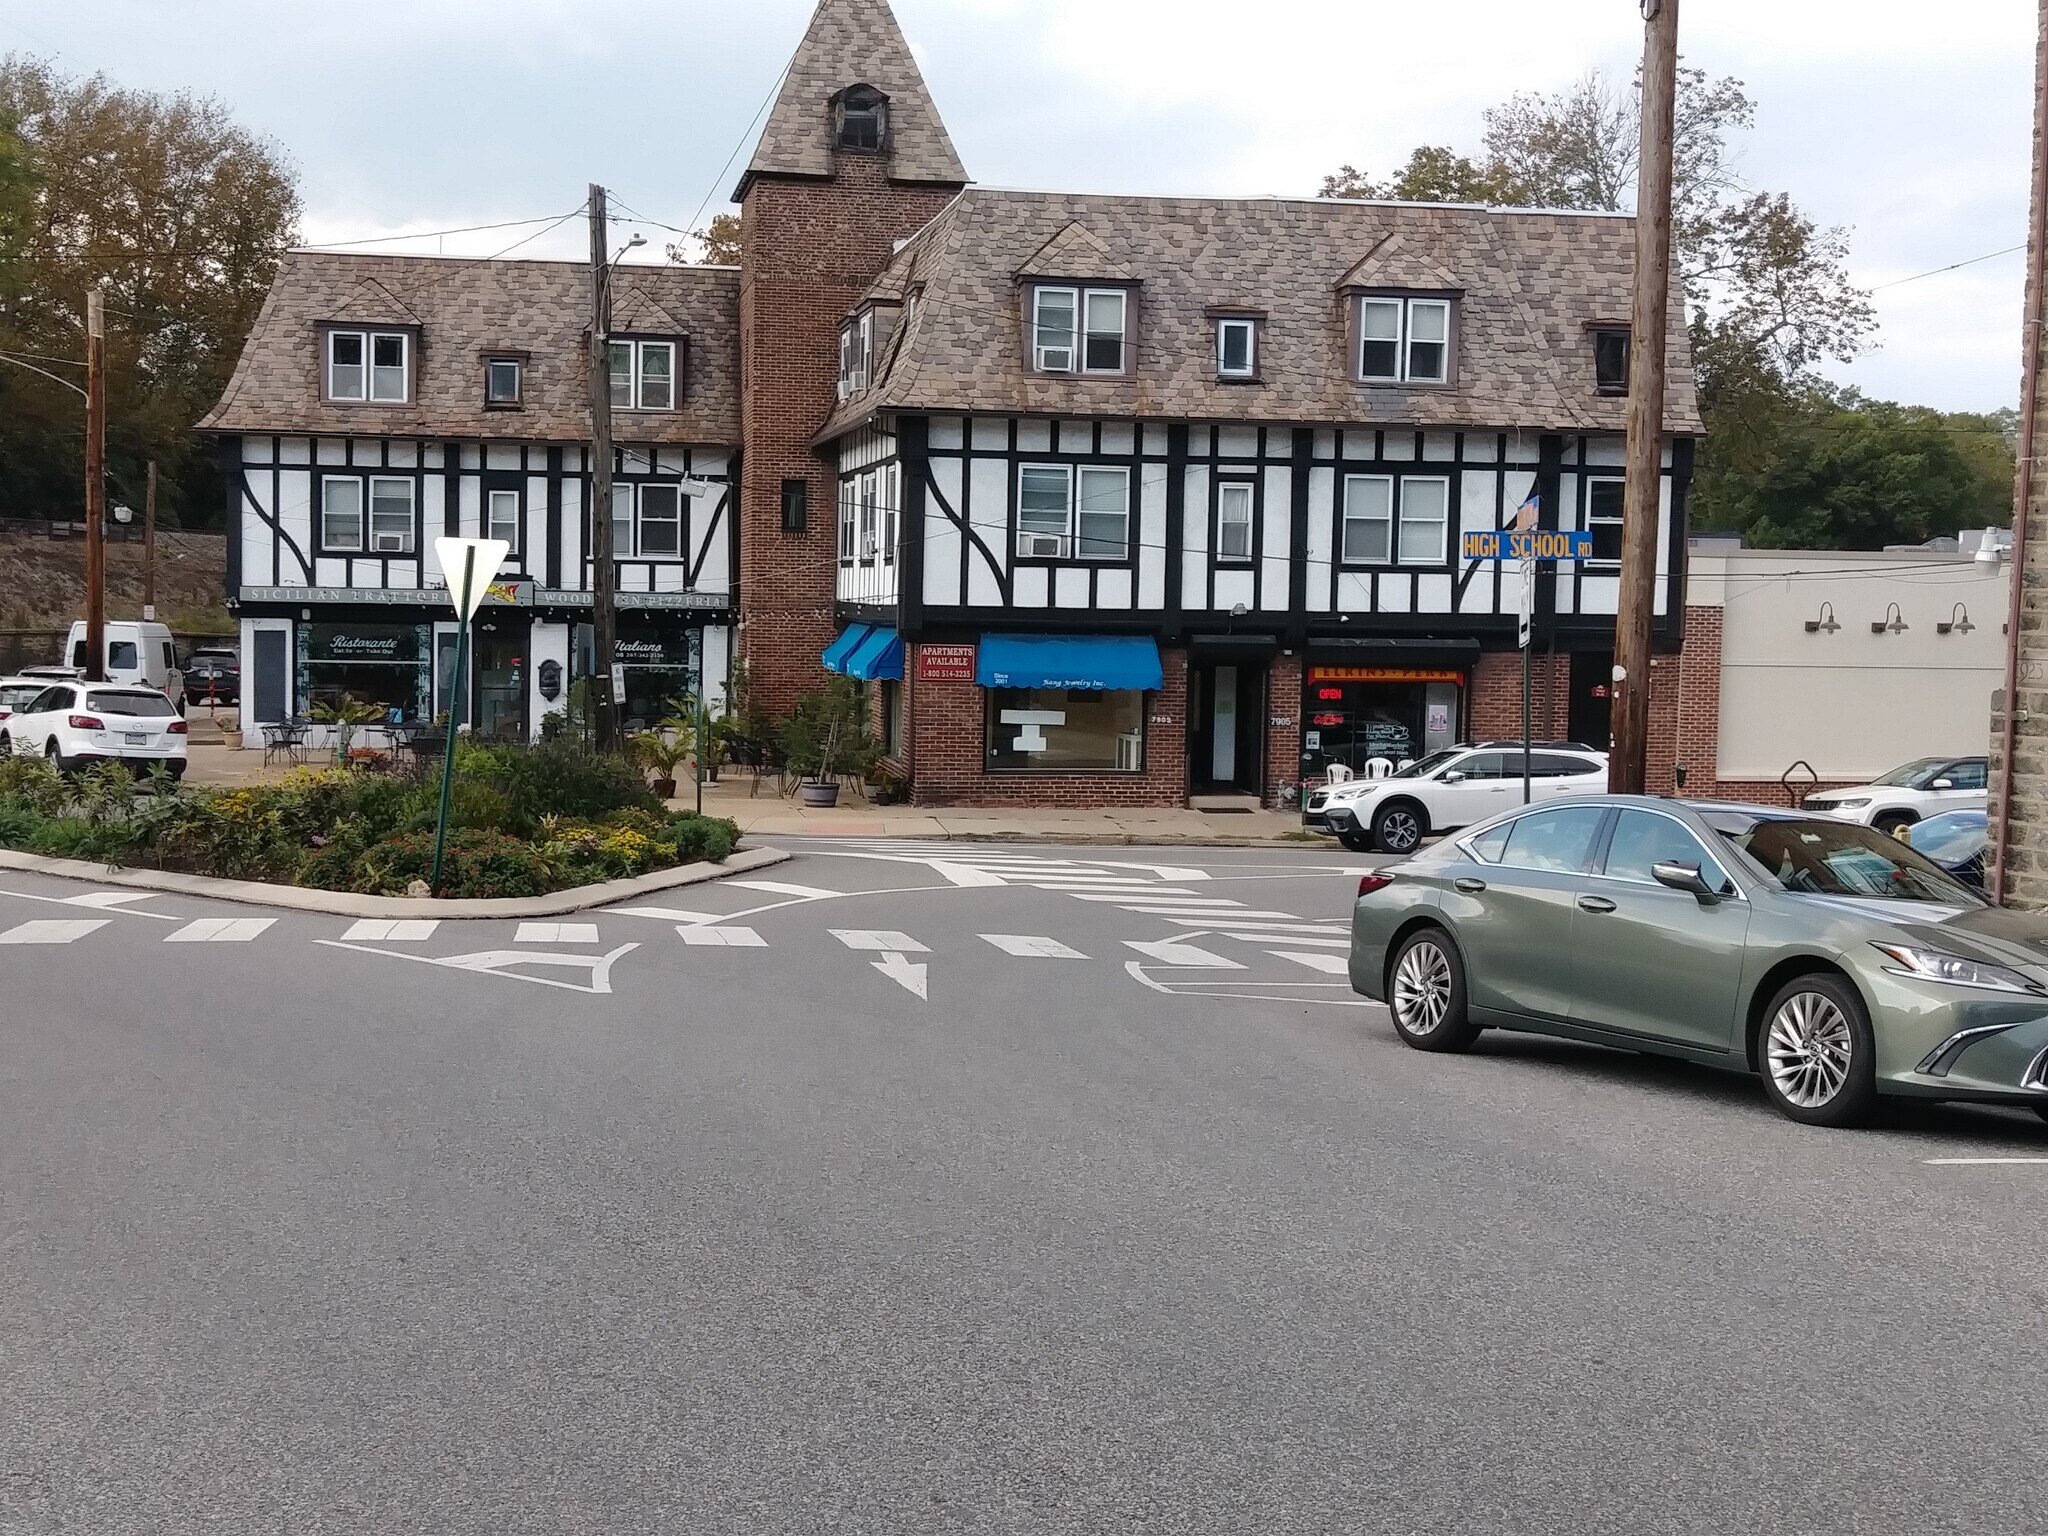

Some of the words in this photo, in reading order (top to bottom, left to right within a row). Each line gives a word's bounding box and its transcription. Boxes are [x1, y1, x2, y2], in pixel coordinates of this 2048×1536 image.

[1465, 533, 1500, 557] HIGH
[1509, 533, 1574, 557] SCHOOL
[1577, 541, 1592, 557] RD
[251, 589, 341, 601] SICILIAN
[352, 590, 449, 602] TRATTORI
[544, 593, 591, 604] WOOD
[647, 595, 721, 607] PIZZERIA
[614, 639, 662, 652] Italiano
[922, 647, 973, 656] APARTMENTS
[926, 657, 968, 666] AVAILABLE
[1319, 688, 1342, 699] OPEN
[1270, 717, 1291, 726] 7905
